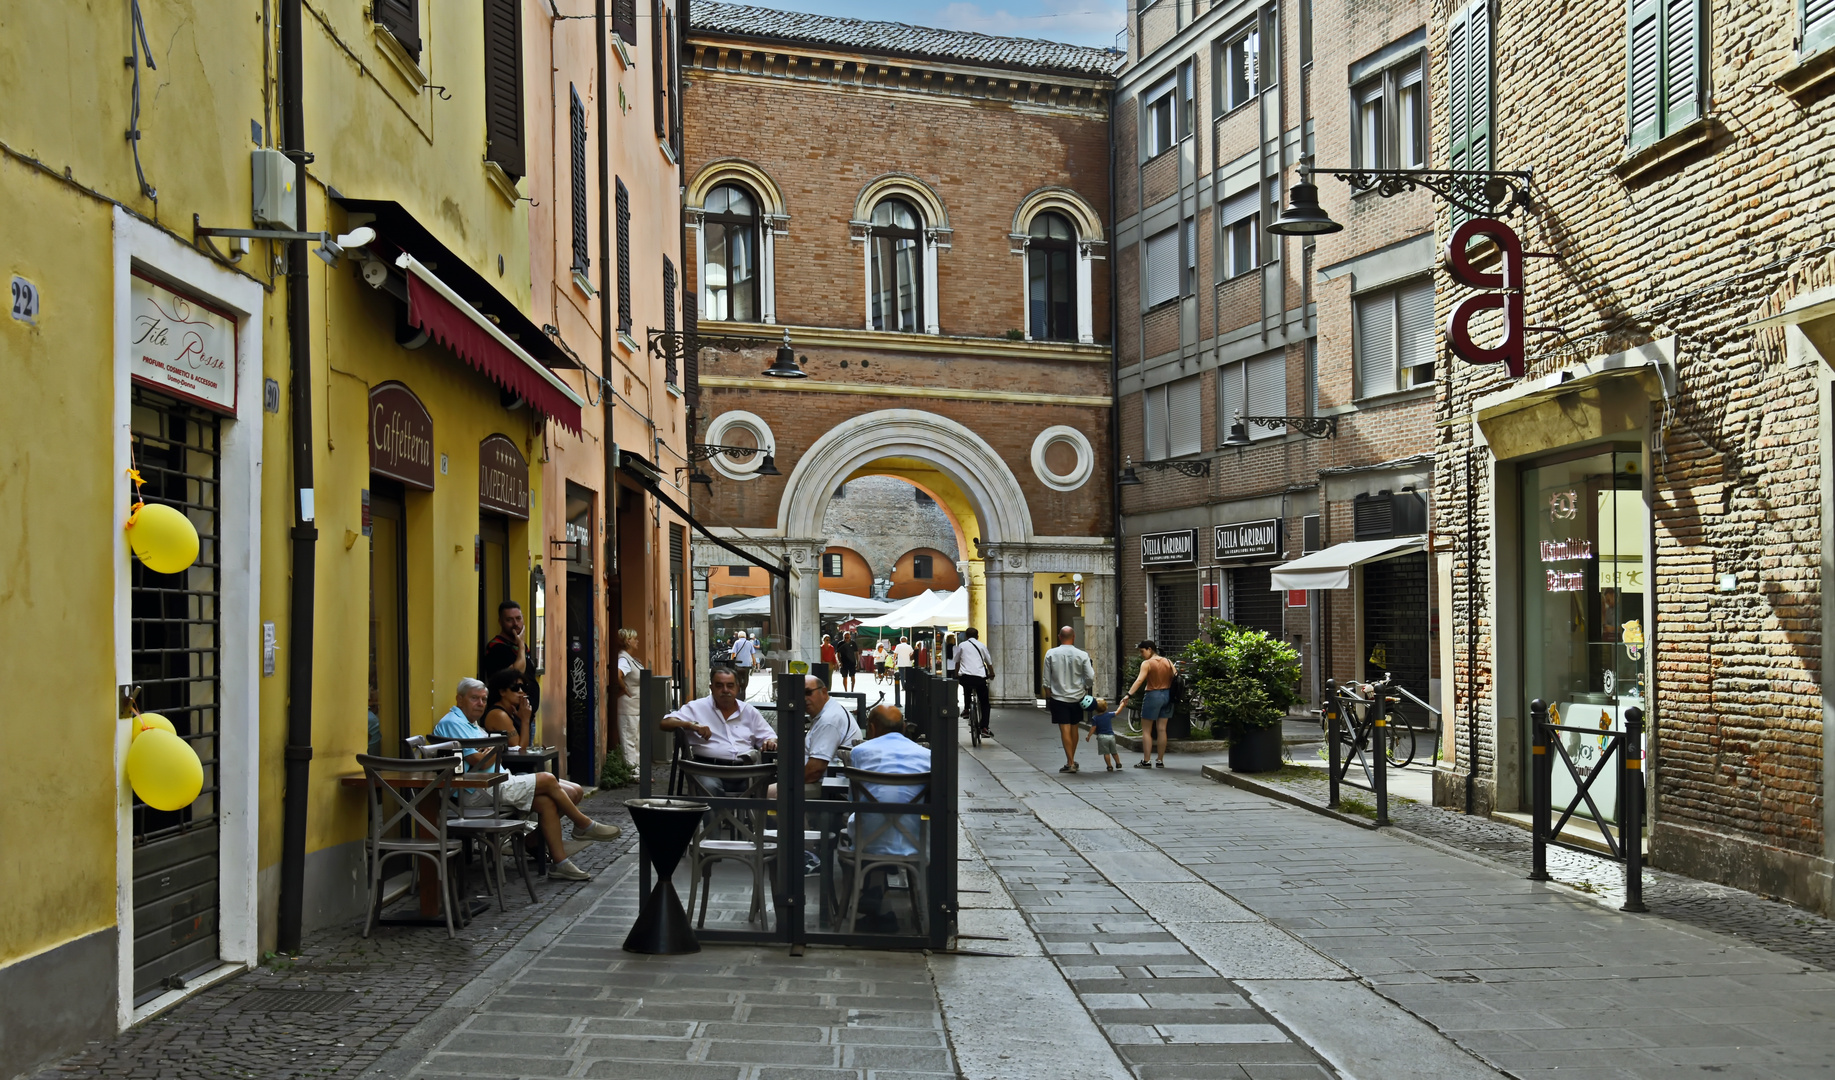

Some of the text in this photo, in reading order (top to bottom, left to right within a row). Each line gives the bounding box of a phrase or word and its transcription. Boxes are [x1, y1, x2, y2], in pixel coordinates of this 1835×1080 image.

[12, 281, 33, 317] 22
[132, 314, 226, 370] Filo Rosso
[166, 364, 191, 379] COSMETICI
[194, 375, 218, 389] ACCESSORI
[373, 402, 430, 467] Caffetteria
[480, 465, 528, 509] IMPERIAL Bar
[1143, 535, 1191, 556] STELLA GARIBALDI
[1216, 526, 1274, 549] STELLA GARIBALDI
